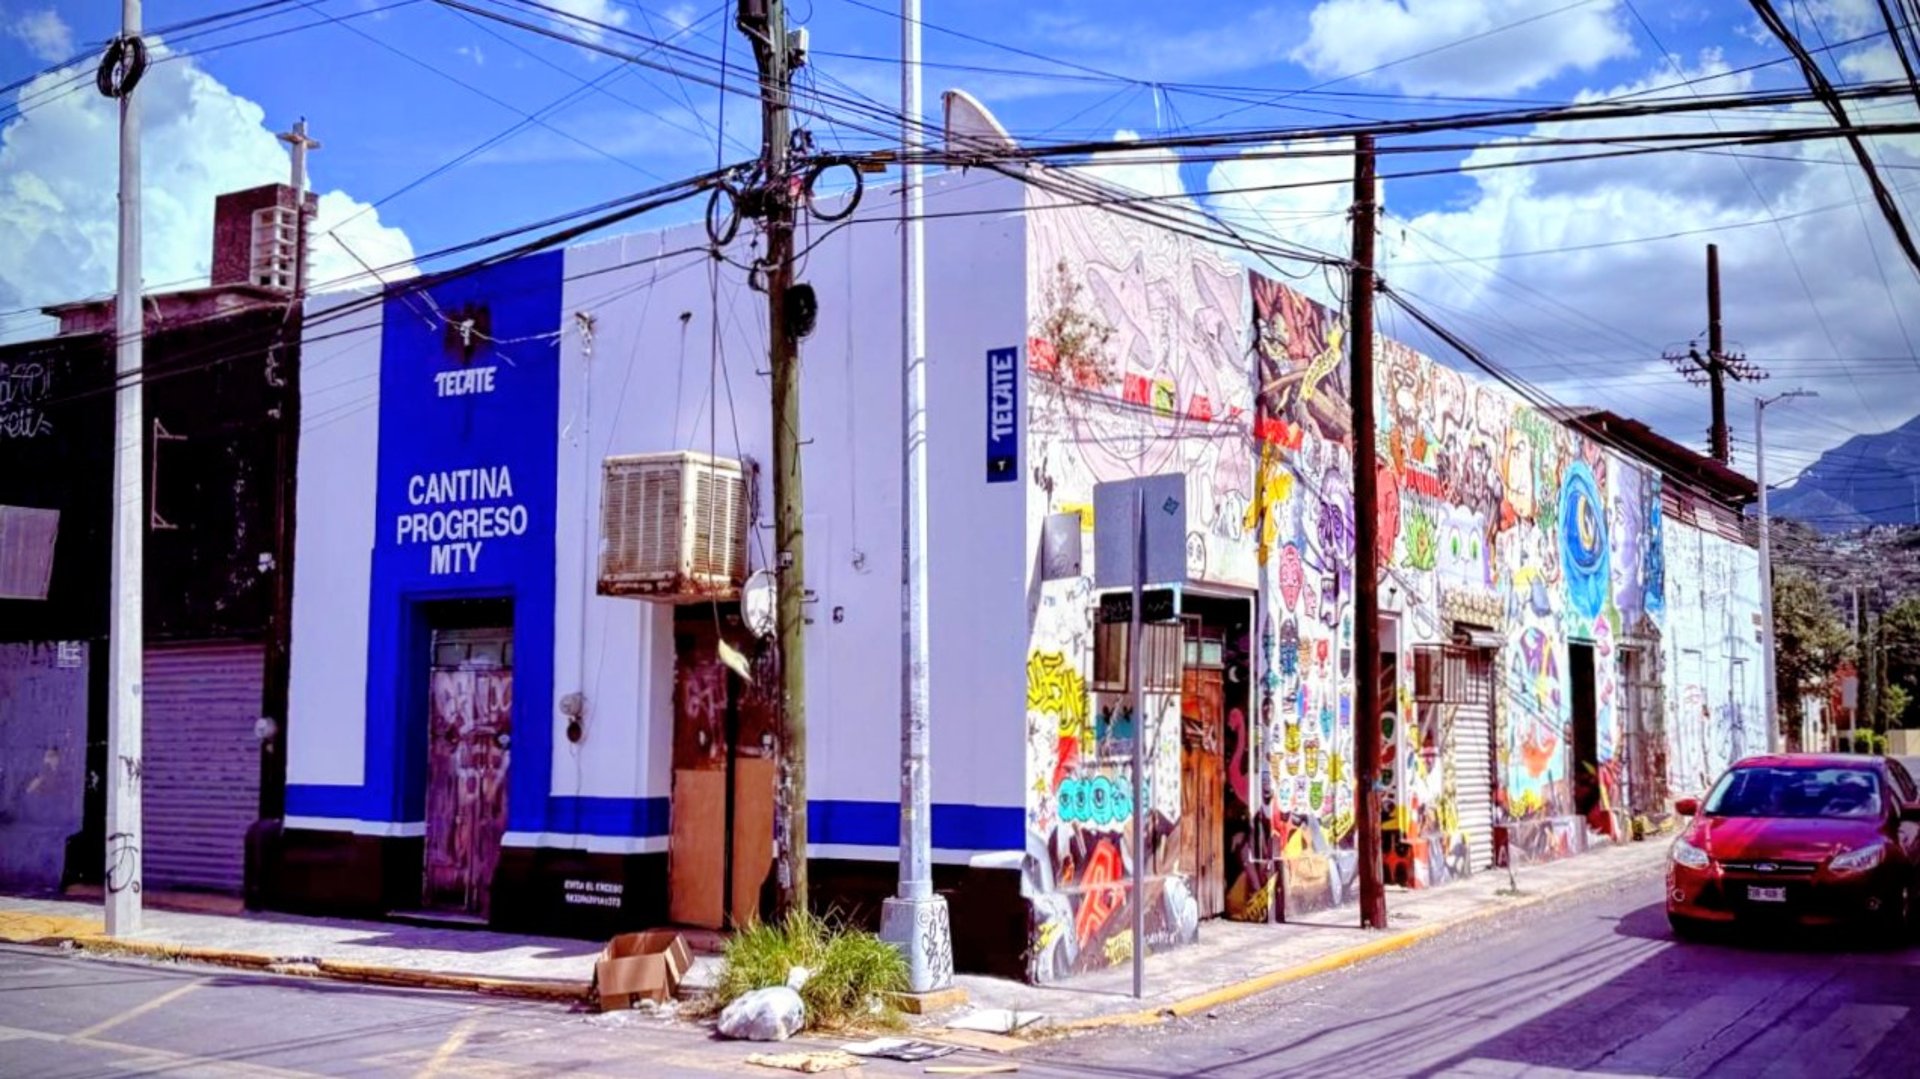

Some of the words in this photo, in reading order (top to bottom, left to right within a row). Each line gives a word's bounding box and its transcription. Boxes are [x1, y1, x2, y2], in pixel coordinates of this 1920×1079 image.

[434, 366, 497, 397] TECATE
[991, 354, 1013, 442] TECATE
[408, 465, 513, 505] CANTINA
[396, 504, 528, 545] PROGRESO
[430, 541, 482, 575] MTY
